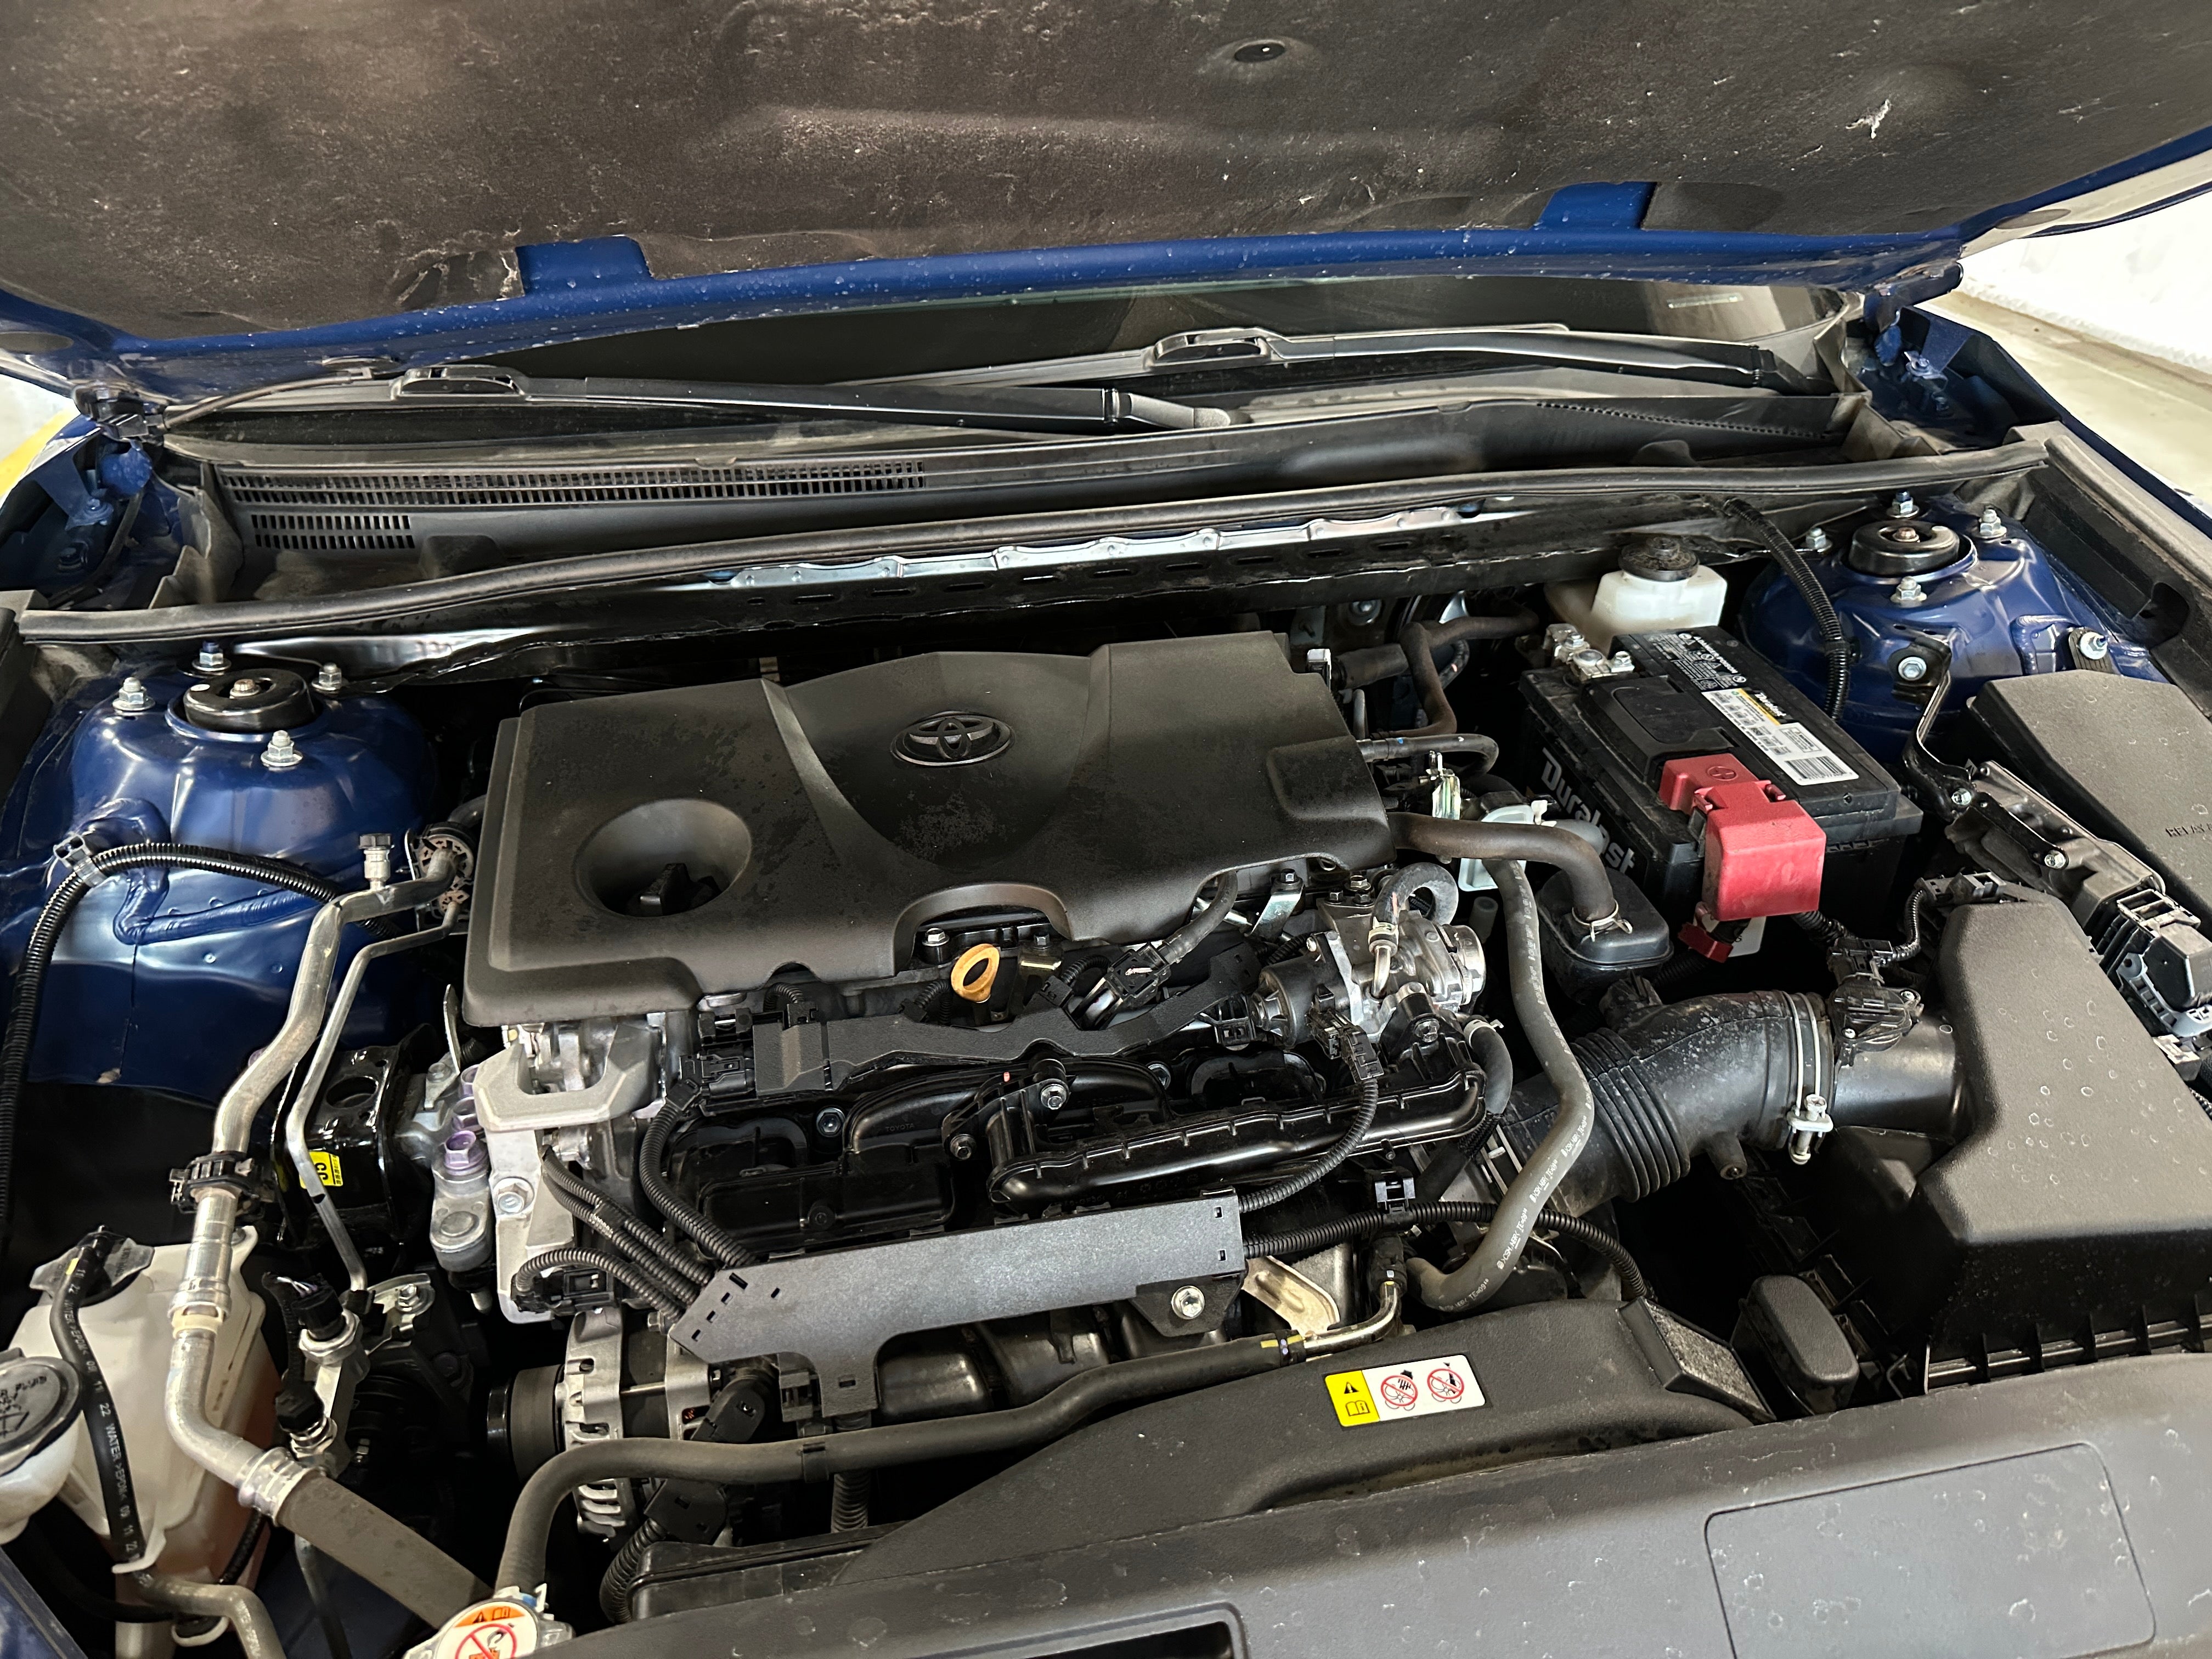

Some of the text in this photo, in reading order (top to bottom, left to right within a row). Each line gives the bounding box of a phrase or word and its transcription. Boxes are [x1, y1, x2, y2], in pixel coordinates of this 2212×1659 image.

[1755, 692, 1787, 717] Duralast
[885, 1123, 915, 1133] TOYOTA
[99, 1403, 111, 1418] 22
[104, 1423, 122, 1462] WATER
[126, 1541, 138, 1552] 22
